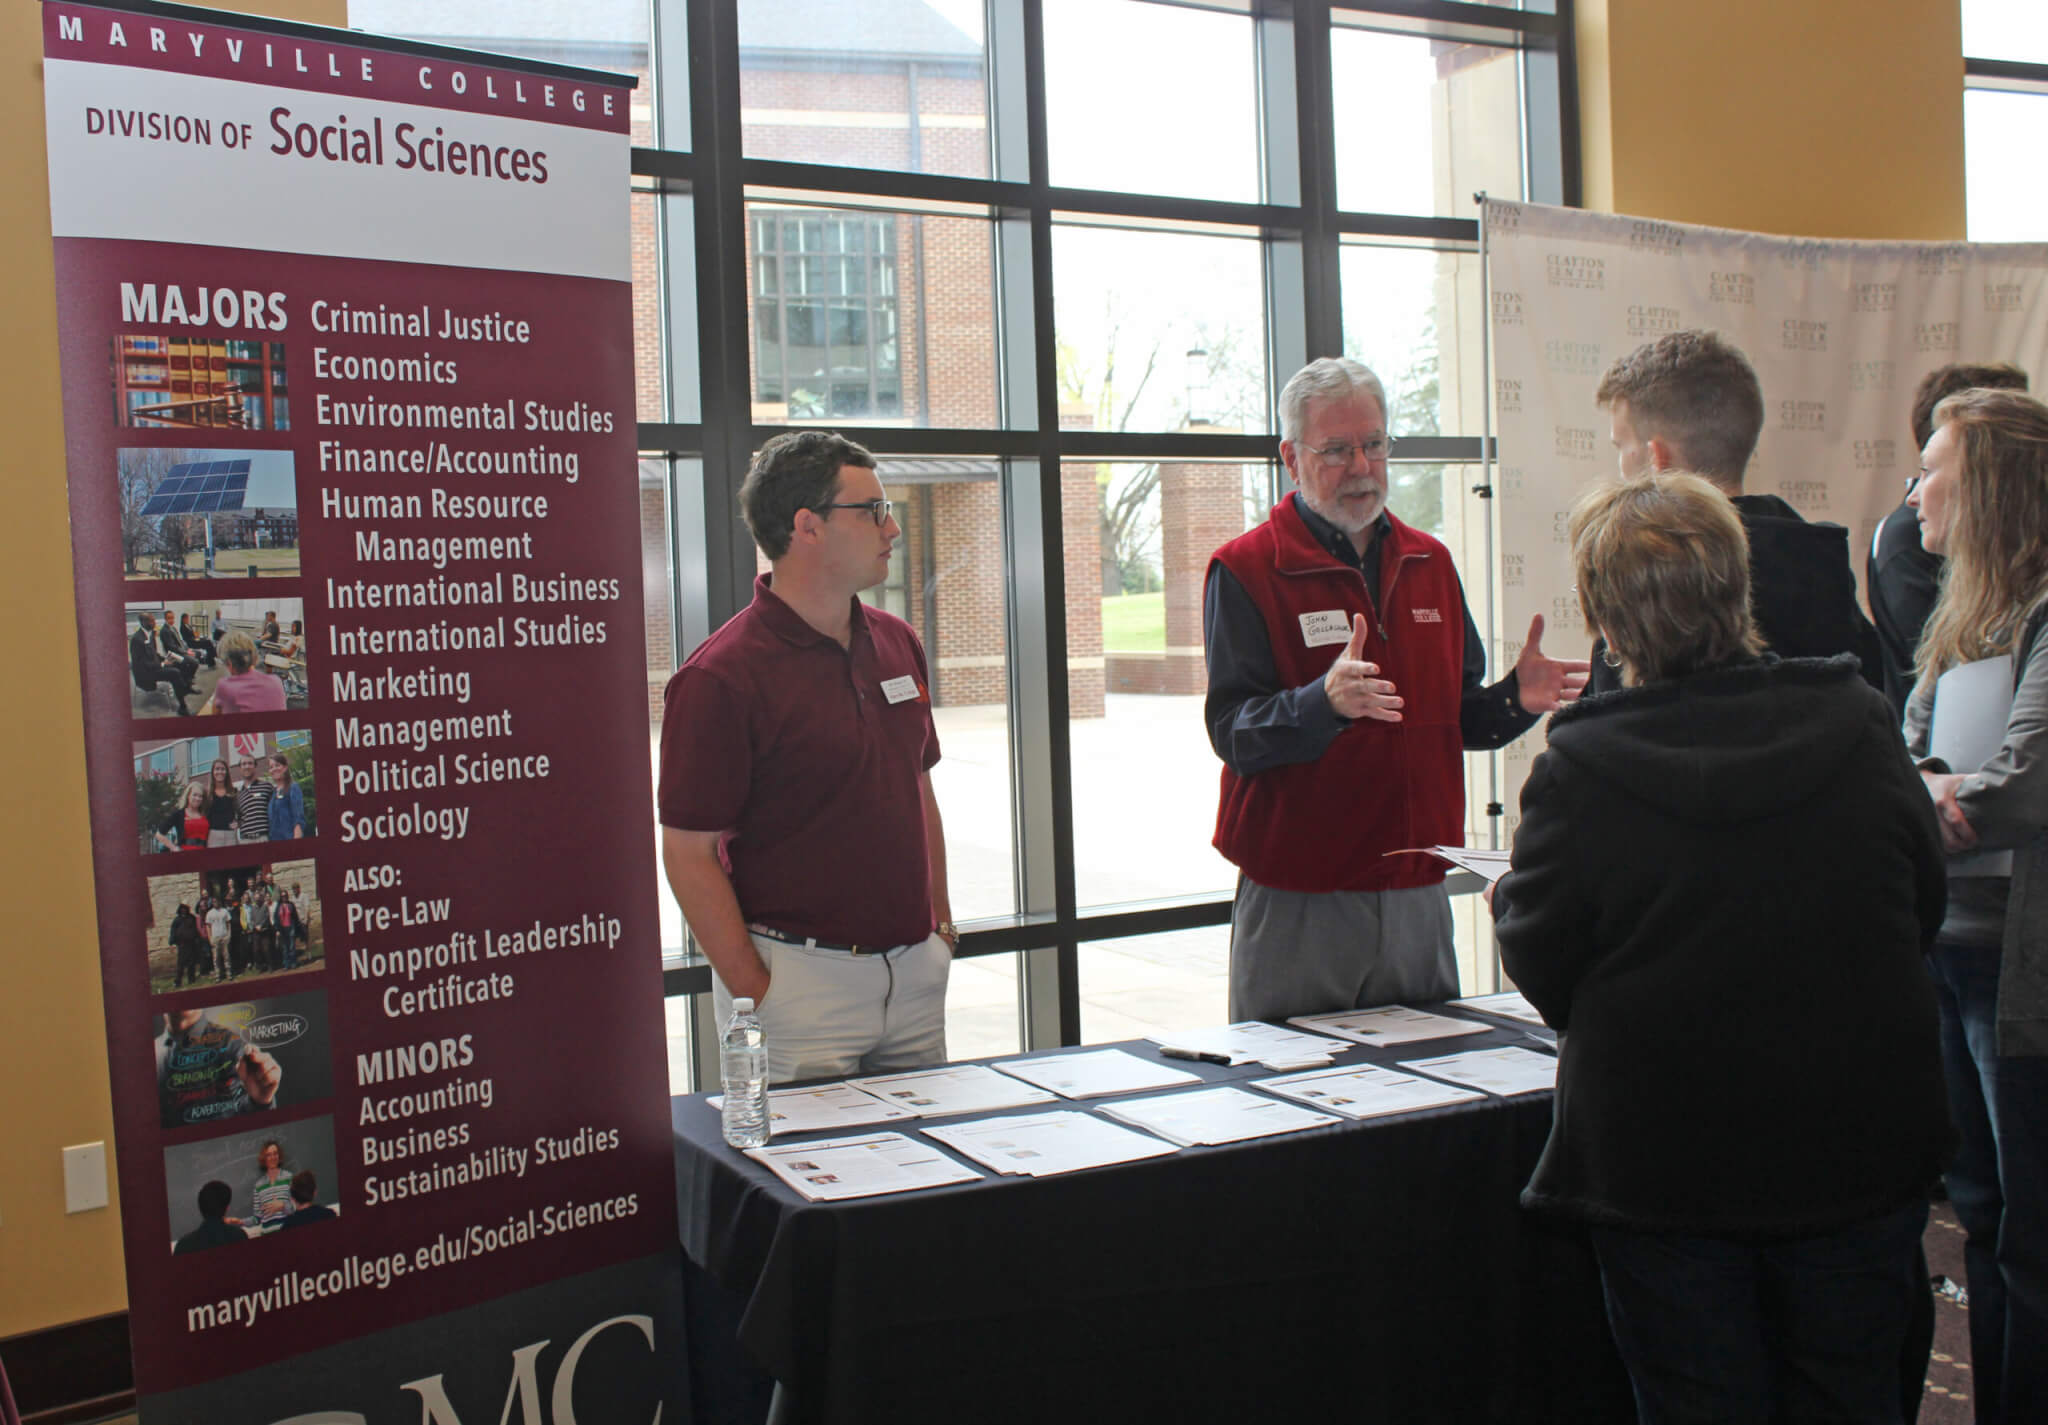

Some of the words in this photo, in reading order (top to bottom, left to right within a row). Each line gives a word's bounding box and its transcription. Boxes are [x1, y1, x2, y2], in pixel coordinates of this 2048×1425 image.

[59, 15, 374, 82] MARYVILLE
[418, 66, 615, 117] COLLEGE
[86, 107, 211, 146] DIVISION
[221, 121, 252, 150] OF
[269, 106, 384, 166] Social
[395, 122, 548, 184] Sciences
[1546, 254, 1605, 269] CLAYTON
[1546, 266, 1604, 281] CENTER
[120, 282, 288, 332] MAJORS
[311, 300, 430, 337] Criminal
[438, 308, 530, 343] Justice
[313, 347, 457, 384] Economics
[316, 393, 515, 430] Environmental
[524, 400, 614, 433] Studies
[319, 440, 579, 484] Finance/Accounting
[321, 487, 422, 519] Human
[431, 488, 548, 519] Resource
[355, 530, 533, 570] Management
[327, 572, 503, 609] International
[512, 572, 620, 603] Business
[329, 616, 505, 656] International
[513, 614, 607, 648] Studies
[332, 665, 471, 704] Marketing
[335, 709, 513, 752] Management
[338, 754, 446, 796] Political
[454, 751, 550, 785] Science
[340, 802, 469, 843] Sociology
[343, 864, 402, 893] ALSO:
[347, 896, 451, 934] Pre-Law
[350, 931, 478, 982] Nonprofit
[484, 913, 621, 959] Leadership
[383, 972, 514, 1018] Certificate
[249, 1018, 301, 1040] MARKETING
[356, 1033, 474, 1086] MINORS
[359, 1077, 493, 1126] Accounting
[362, 1122, 470, 1166] Business
[365, 1145, 528, 1206] Sustainability
[535, 1127, 619, 1165] Studies
[187, 1192, 639, 1332] maryvillecollege.edu/Social-Sciences
